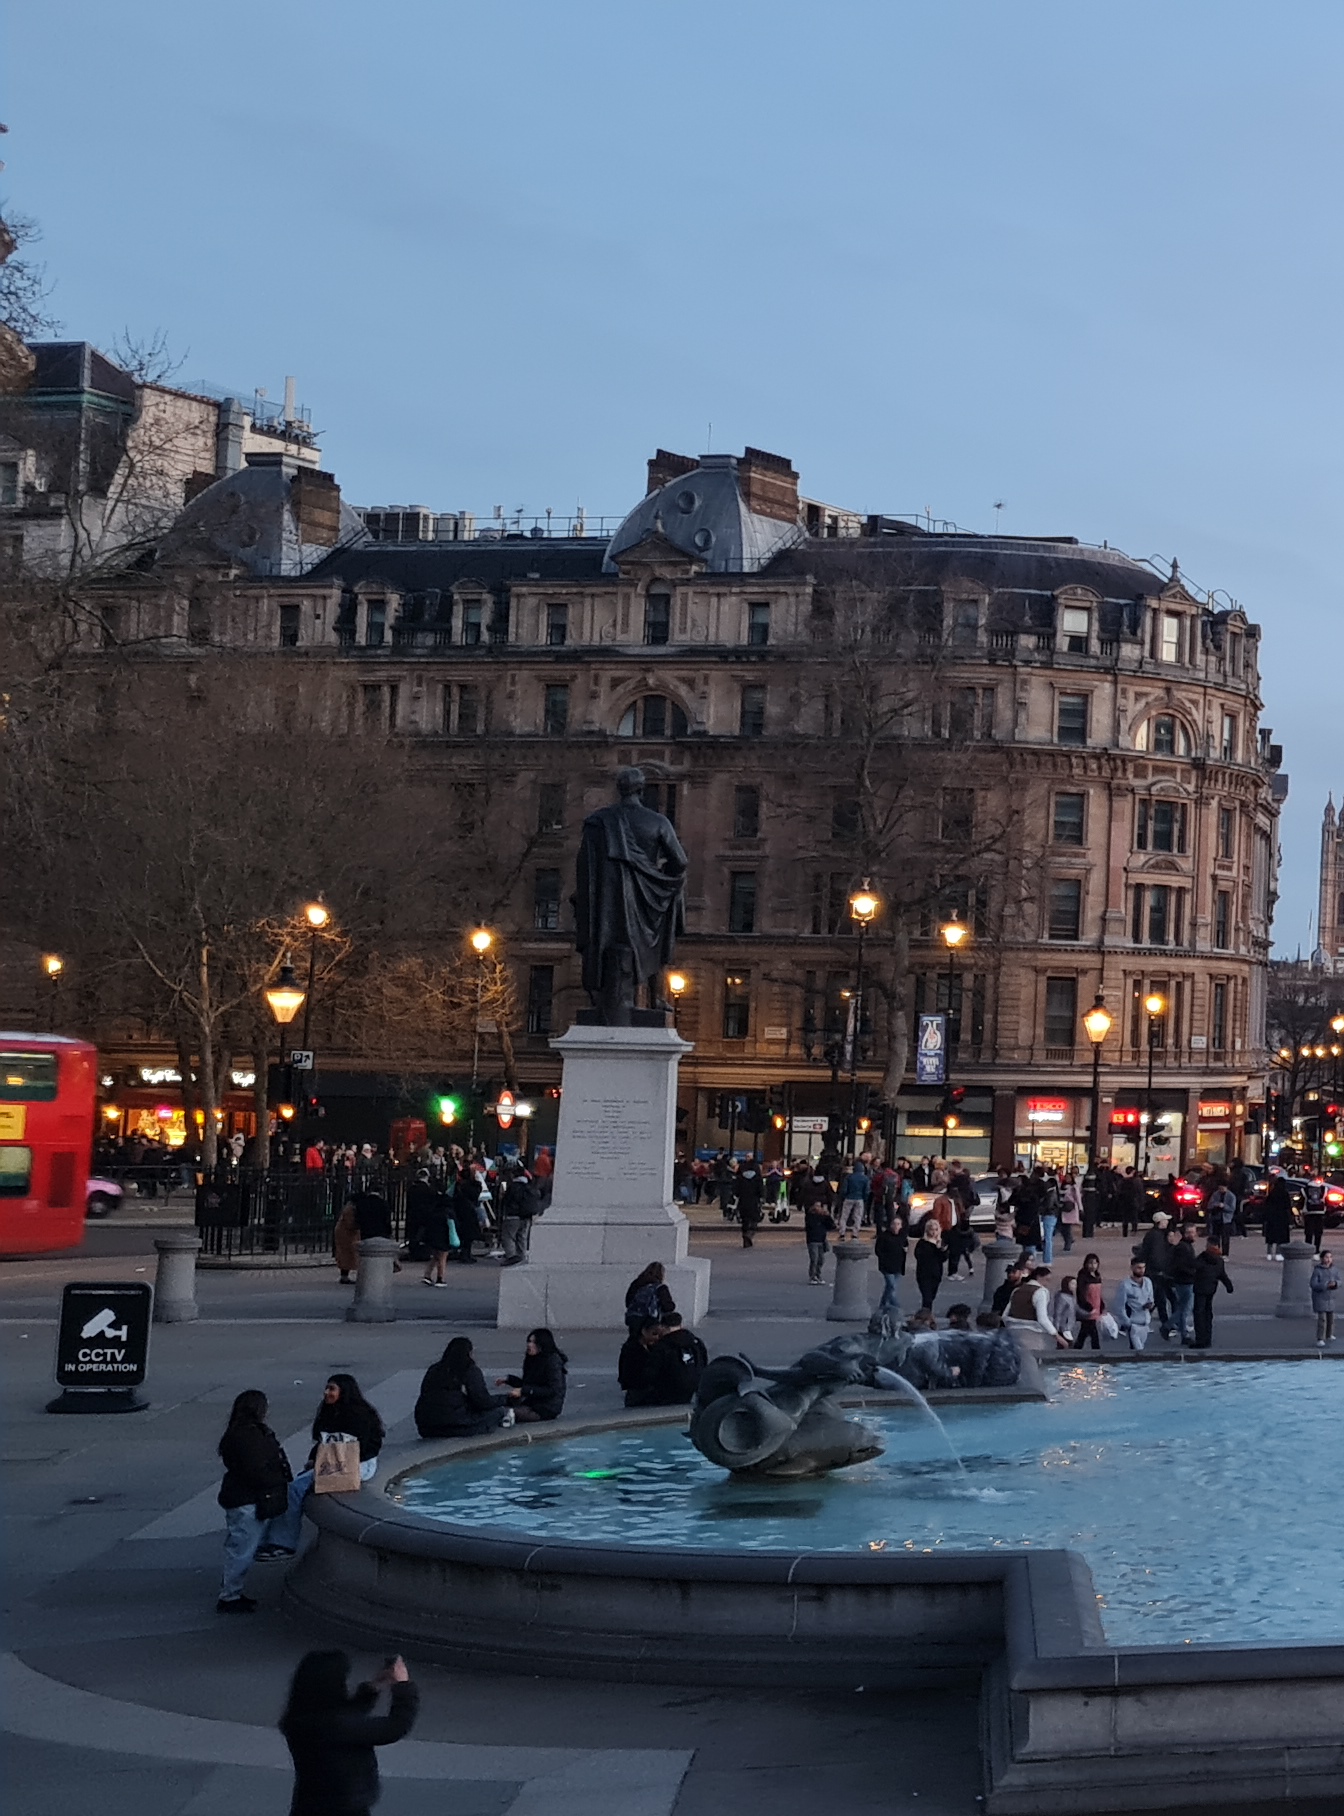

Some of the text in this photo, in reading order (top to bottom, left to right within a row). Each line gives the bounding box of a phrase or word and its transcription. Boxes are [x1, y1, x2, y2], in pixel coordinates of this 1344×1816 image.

[1028, 1101, 1067, 1110] TESCO
[78, 1348, 126, 1362] CCTV
[64, 1363, 138, 1372] IN OPERATION
